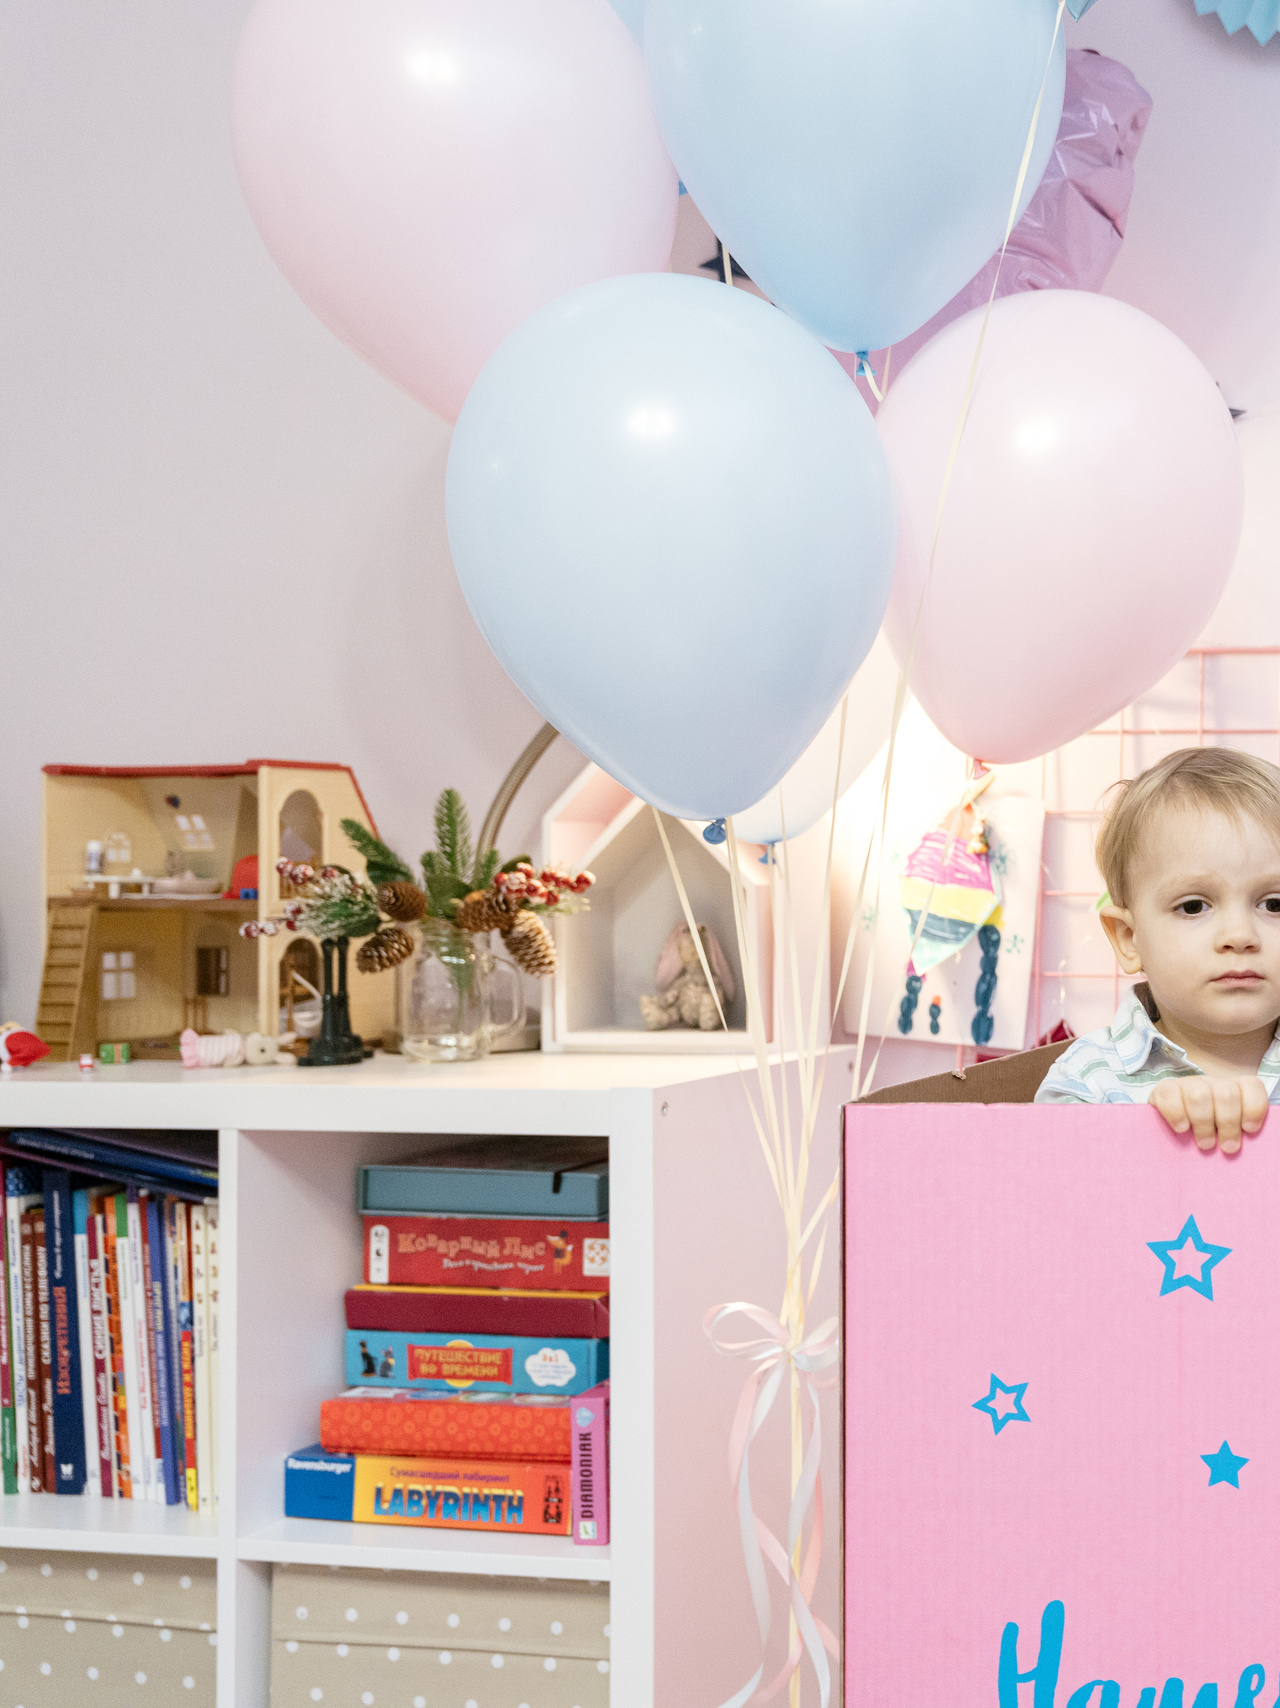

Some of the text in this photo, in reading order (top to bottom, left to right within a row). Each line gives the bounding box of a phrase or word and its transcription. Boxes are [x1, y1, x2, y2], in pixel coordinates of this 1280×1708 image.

[397, 1232, 500, 1258] Коварный
[502, 1236, 546, 1260] Лис
[37, 1246, 49, 1303] ТЕЛЕФОНУ
[89, 1258, 104, 1312] ЛИСТЬЯ
[39, 1303, 50, 1321] ПО
[40, 1322, 51, 1365] СКАЗКИ
[92, 1313, 106, 1360] СИНИЕ
[414, 1348, 503, 1365] ПУТЕШЕСТВИЕ
[420, 1362, 498, 1378] ВО ВРЕМЕНИ
[42, 1378, 54, 1414] Родари
[287, 1457, 353, 1475] Ravensburger
[389, 1466, 510, 1485] Сумасшедший лабиринт
[579, 1431, 595, 1519] DIAMONIAK
[373, 1480, 525, 1525] LABYRINTH
